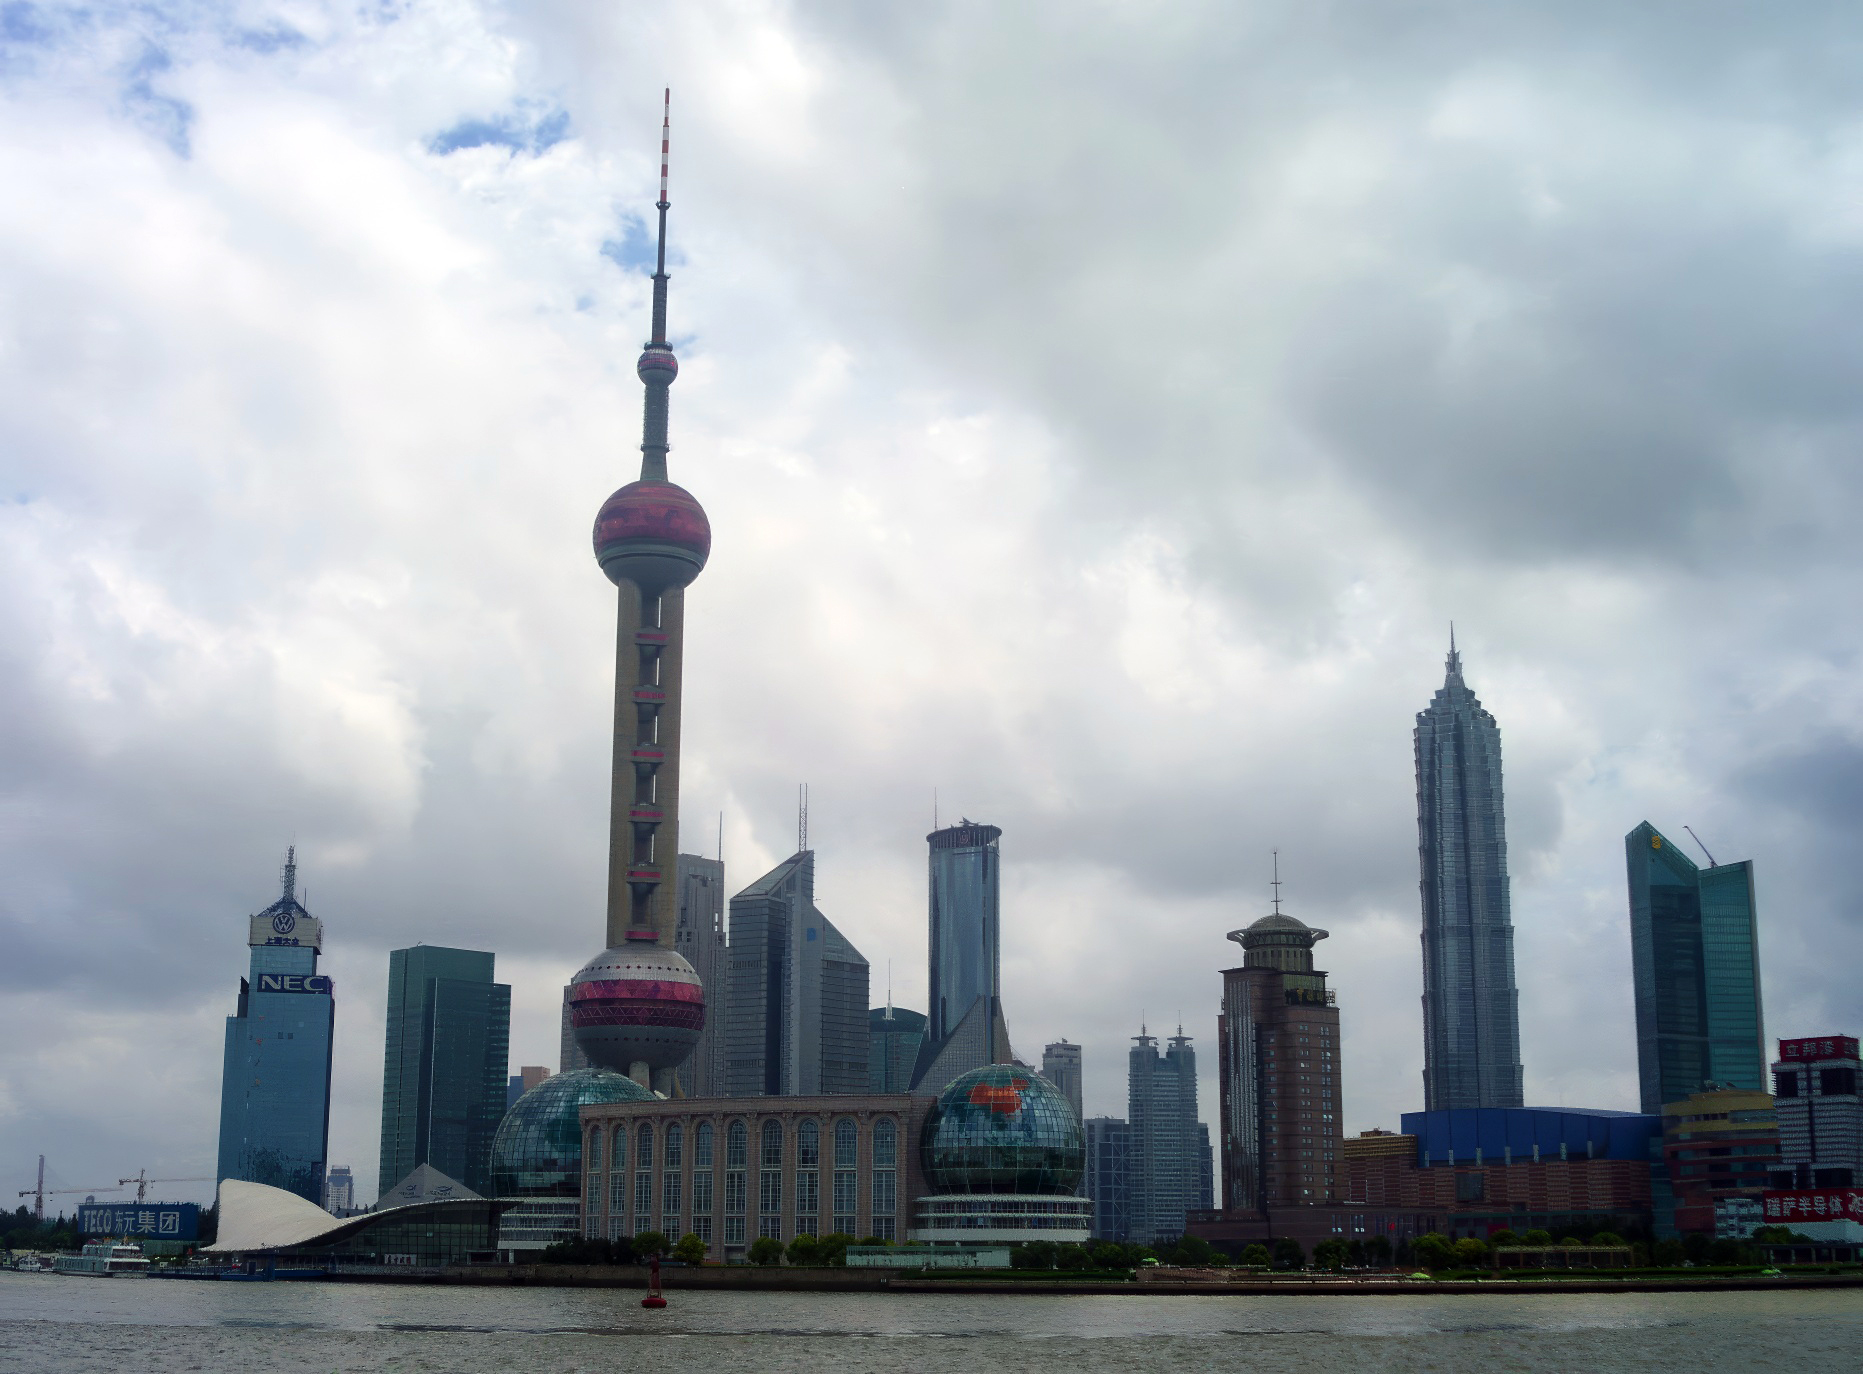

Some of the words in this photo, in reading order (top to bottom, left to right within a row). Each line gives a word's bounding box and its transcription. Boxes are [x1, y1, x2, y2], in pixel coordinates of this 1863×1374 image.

[261, 975, 324, 991] NEC
[83, 1209, 112, 1233] TECO
[114, 1209, 180, 1234] 东元集团
